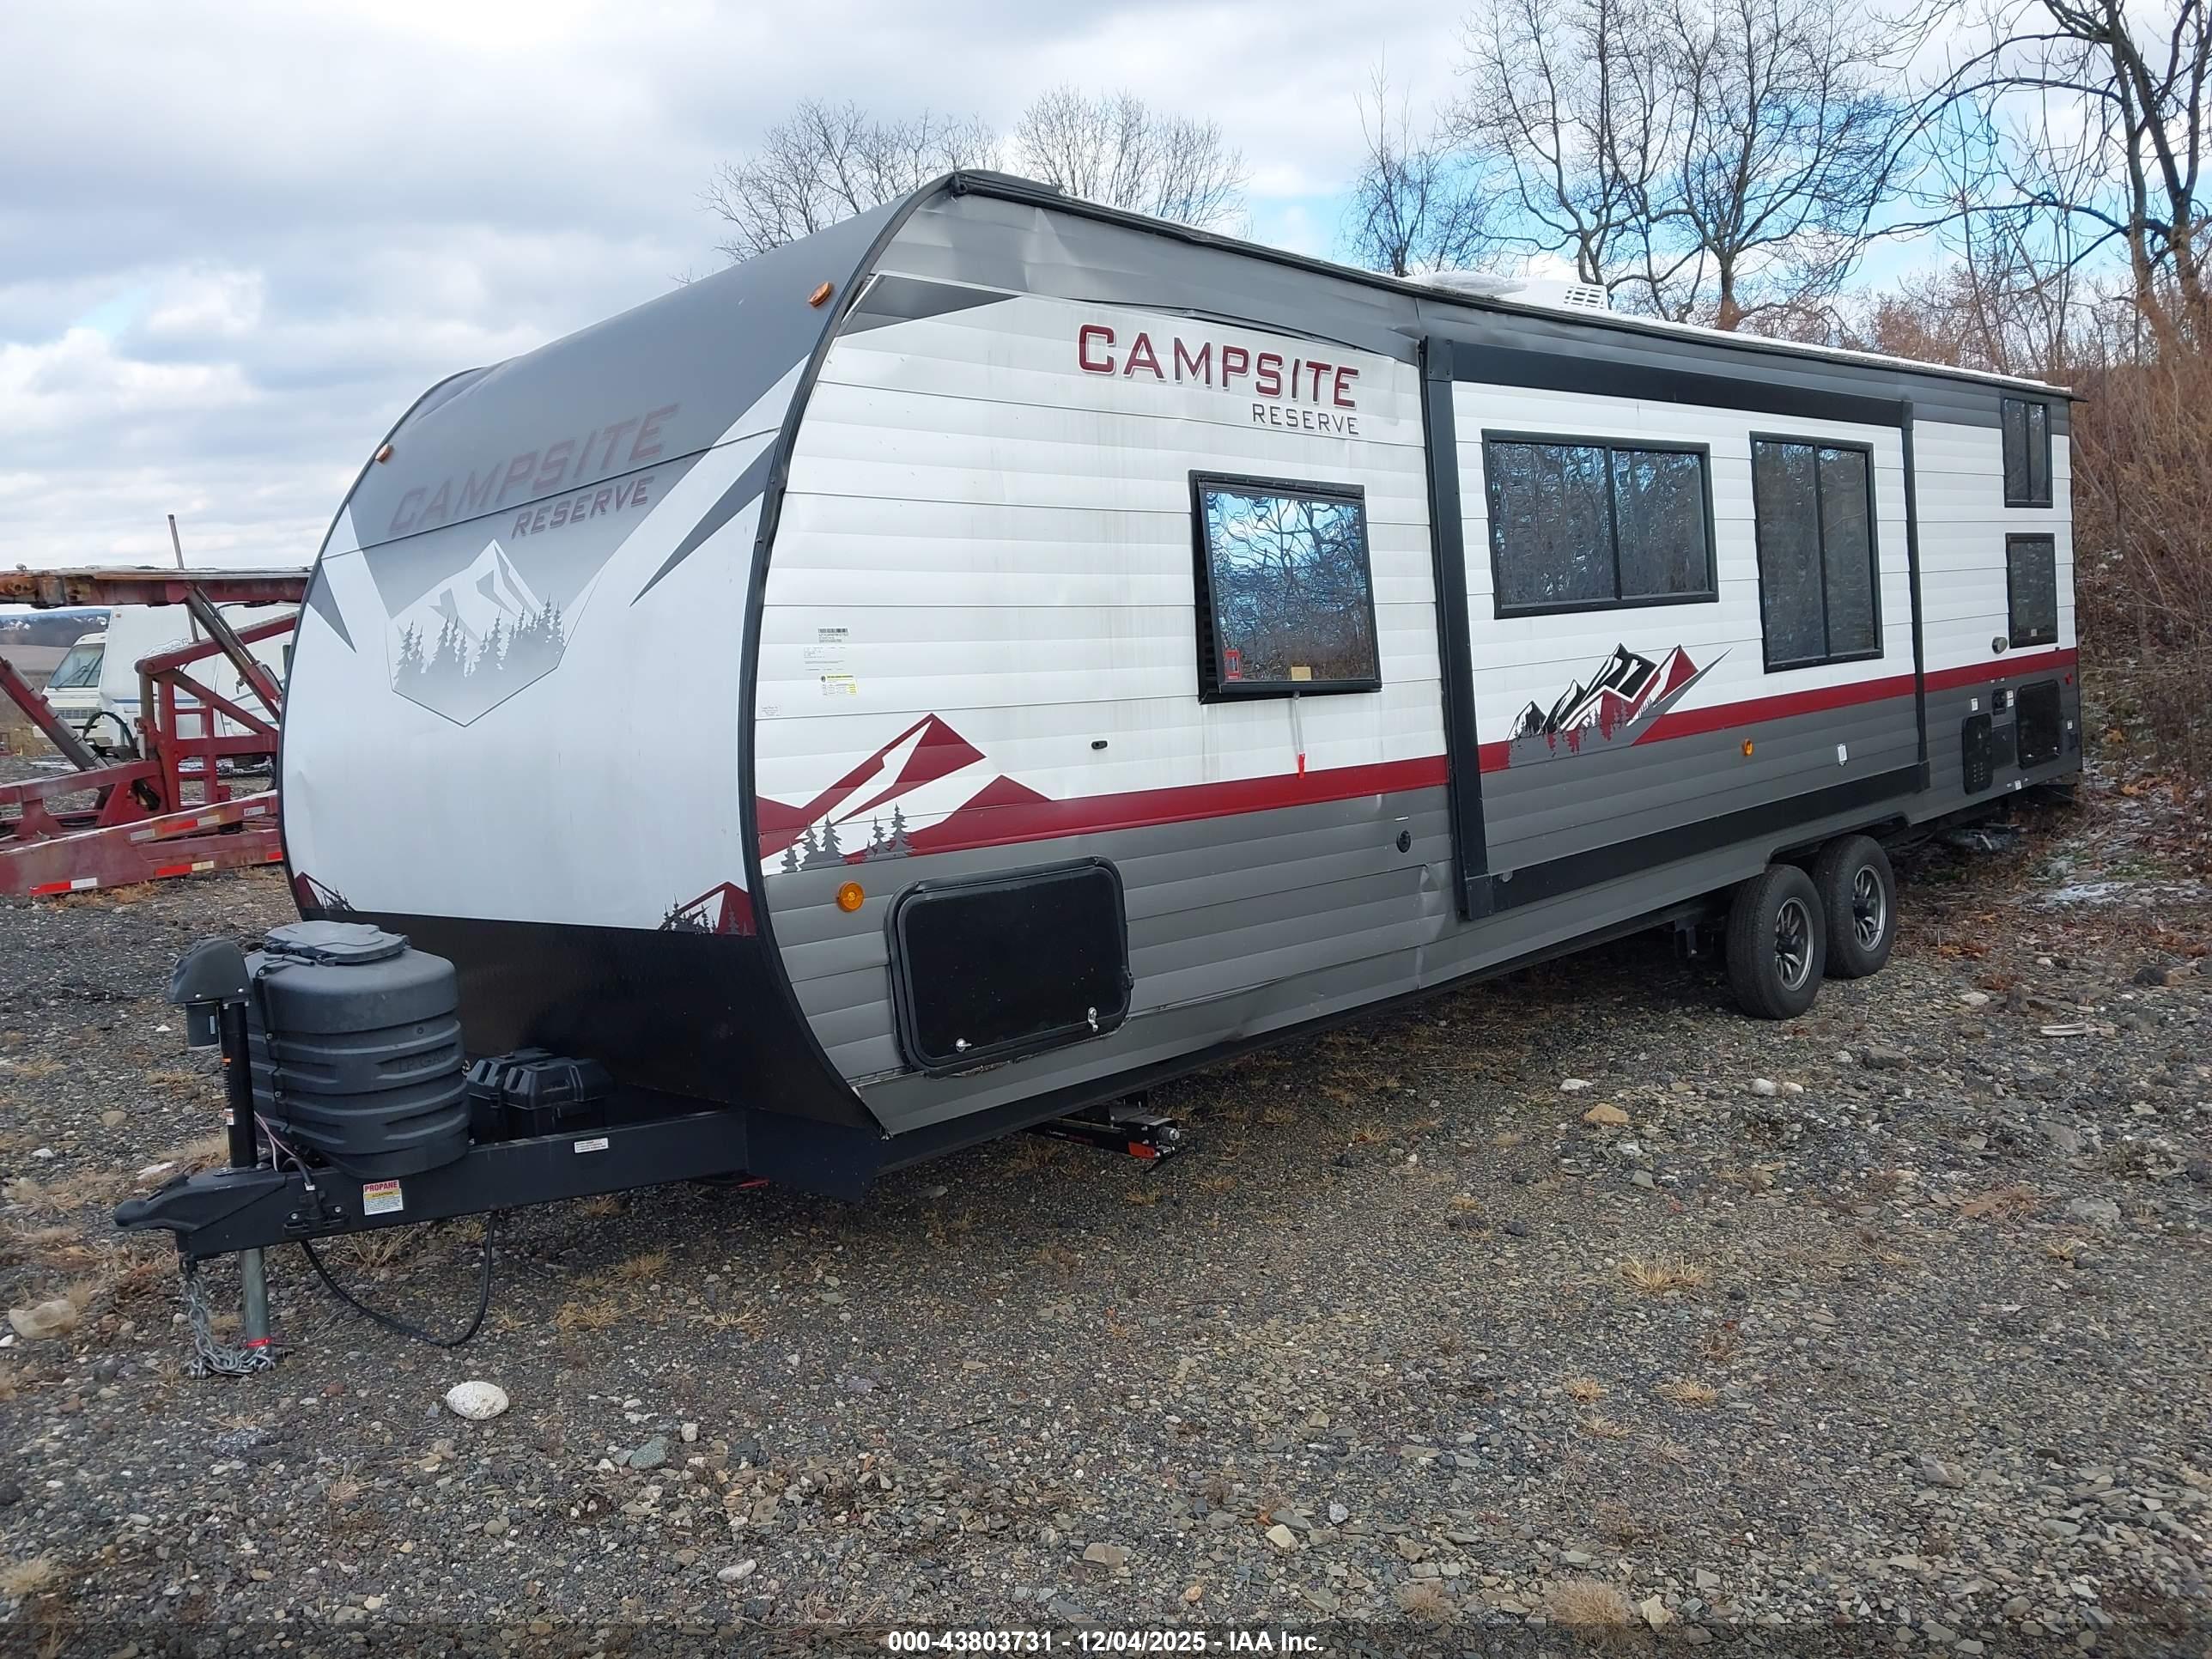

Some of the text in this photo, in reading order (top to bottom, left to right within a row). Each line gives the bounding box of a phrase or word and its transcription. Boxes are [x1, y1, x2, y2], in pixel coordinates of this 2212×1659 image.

[1079, 324, 1359, 407] CAMPSITE
[1252, 403, 1359, 435] RESERVE
[388, 403, 679, 534] CAMPSITE
[510, 475, 655, 539] RESERVE
[364, 1181, 398, 1193] PROPANE
